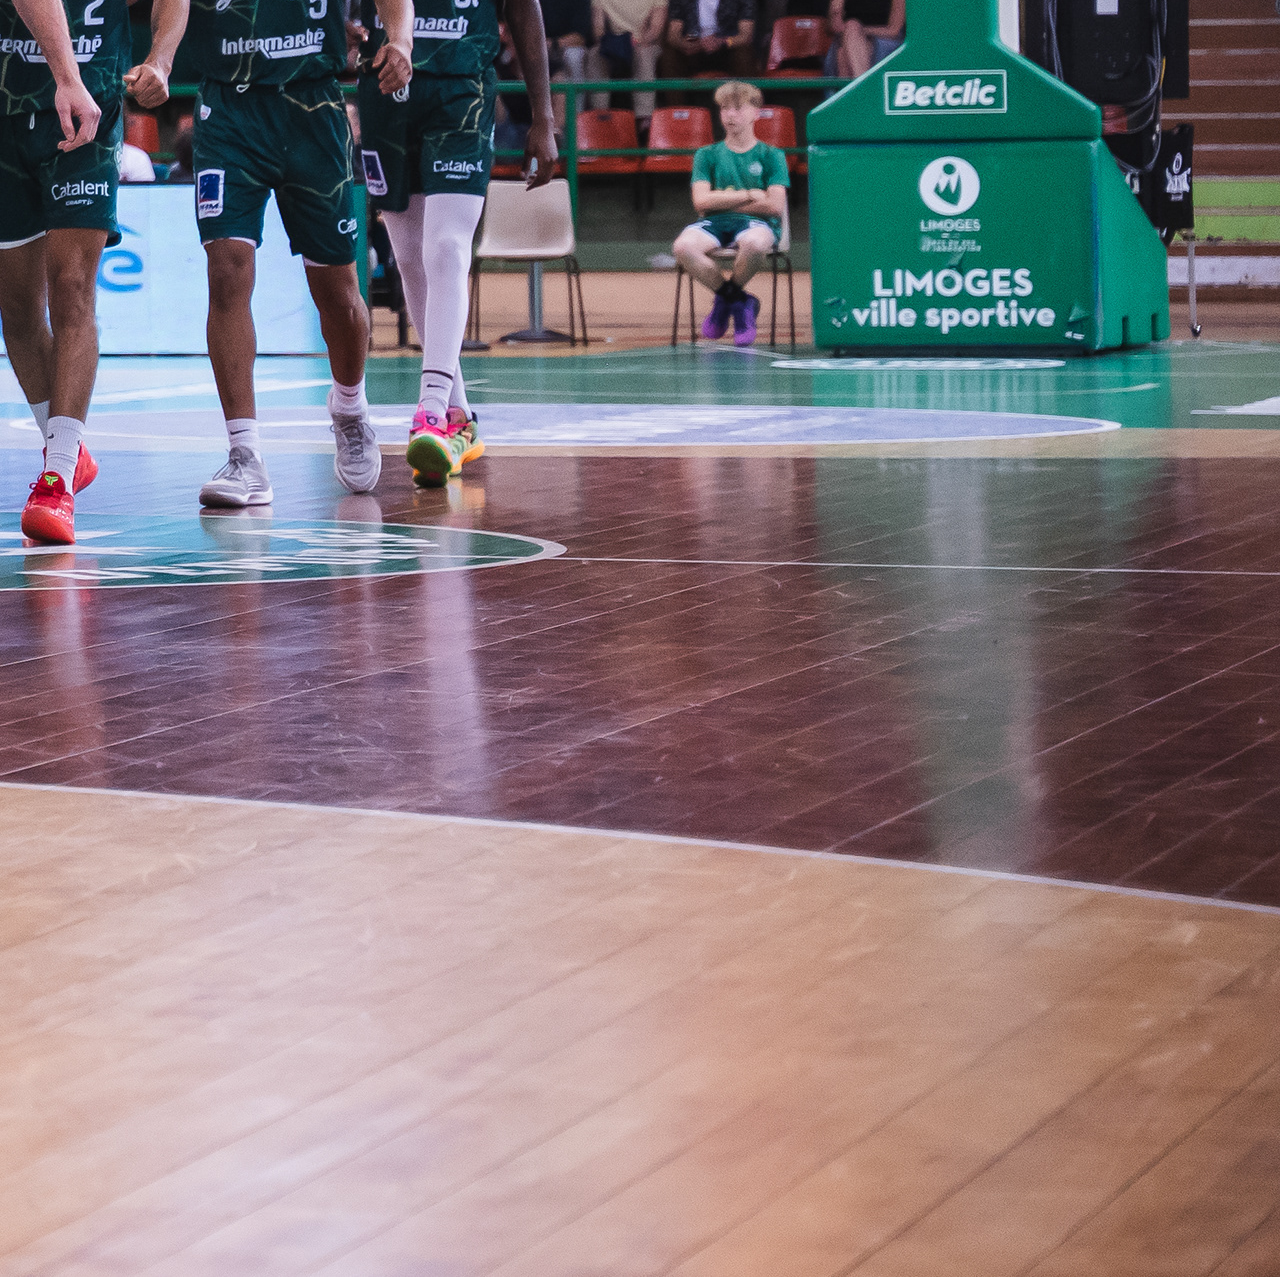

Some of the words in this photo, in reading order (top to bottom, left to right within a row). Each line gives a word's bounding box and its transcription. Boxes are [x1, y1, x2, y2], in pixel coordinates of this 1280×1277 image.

[893, 78, 998, 107] Betclic
[51, 180, 110, 201] Catalent
[920, 218, 982, 232] LIMOGES
[873, 267, 1034, 297] LIMOGES
[852, 297, 918, 328] ville
[924, 300, 1057, 334] sportive
